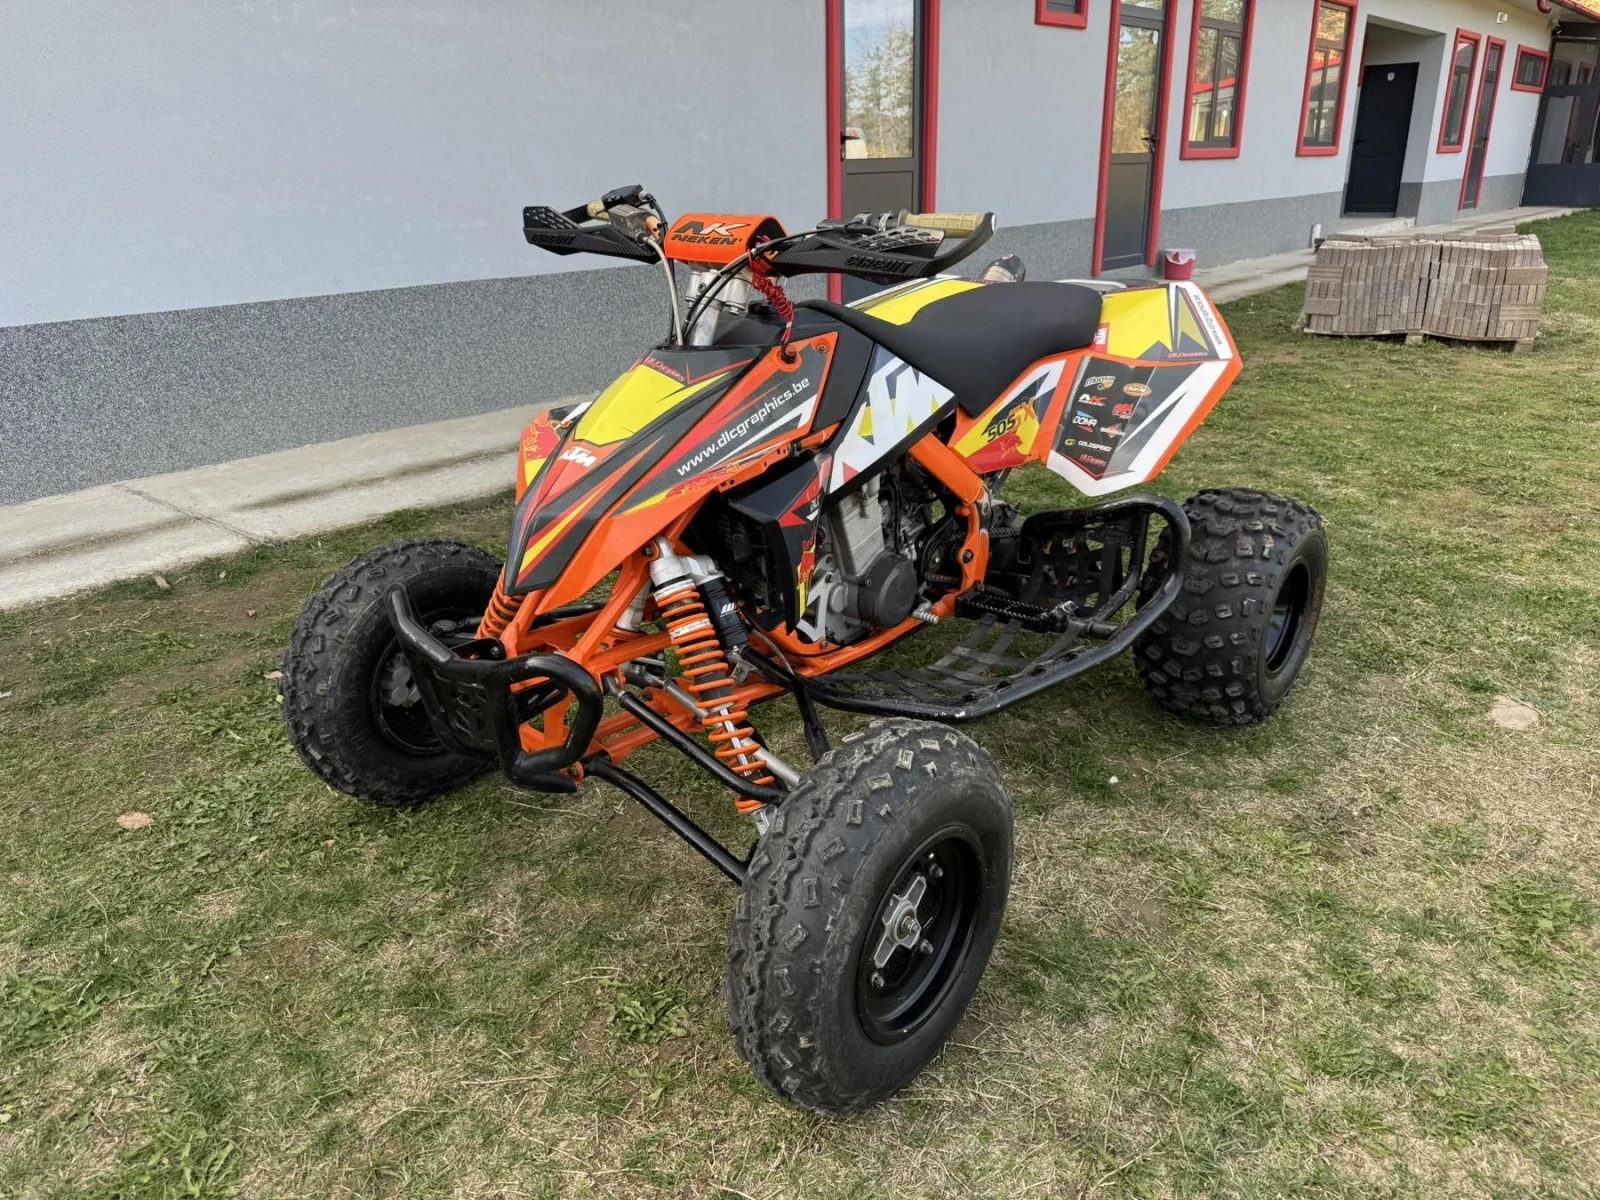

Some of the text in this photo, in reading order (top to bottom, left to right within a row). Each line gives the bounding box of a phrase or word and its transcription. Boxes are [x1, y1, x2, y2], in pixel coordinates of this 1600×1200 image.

[671, 234, 738, 245] NEKEN
[845, 255, 913, 274] CIRCUIT
[676, 377, 810, 477] www.dlcgraphics.be
[1072, 415, 1098, 427] DOMA
[558, 446, 597, 467] KTM
